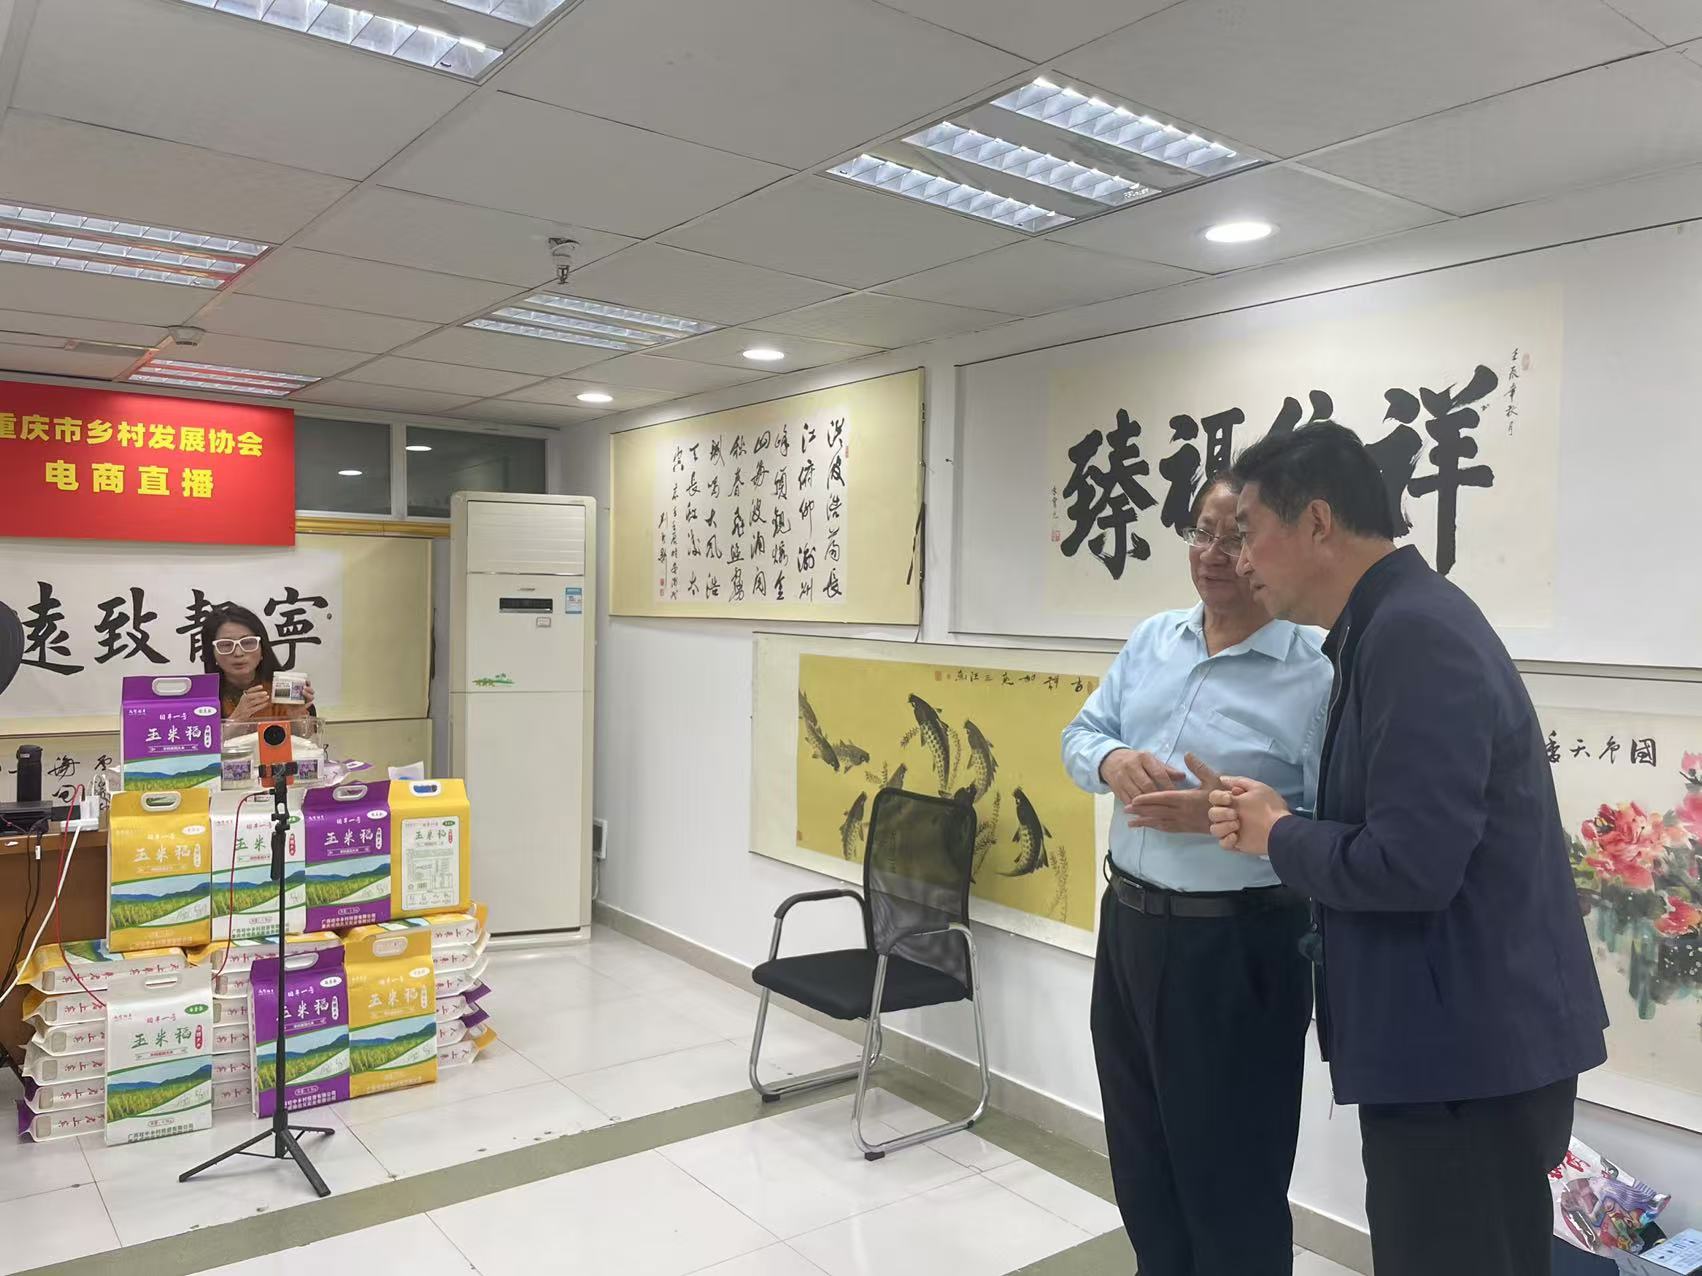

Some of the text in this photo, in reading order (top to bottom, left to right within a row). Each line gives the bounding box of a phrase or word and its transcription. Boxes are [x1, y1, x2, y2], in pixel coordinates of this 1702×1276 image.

[0, 412, 263, 457] 重庆市乡村发展协会
[46, 459, 214, 498] 电商直播
[235, 834, 266, 851] 玉米
